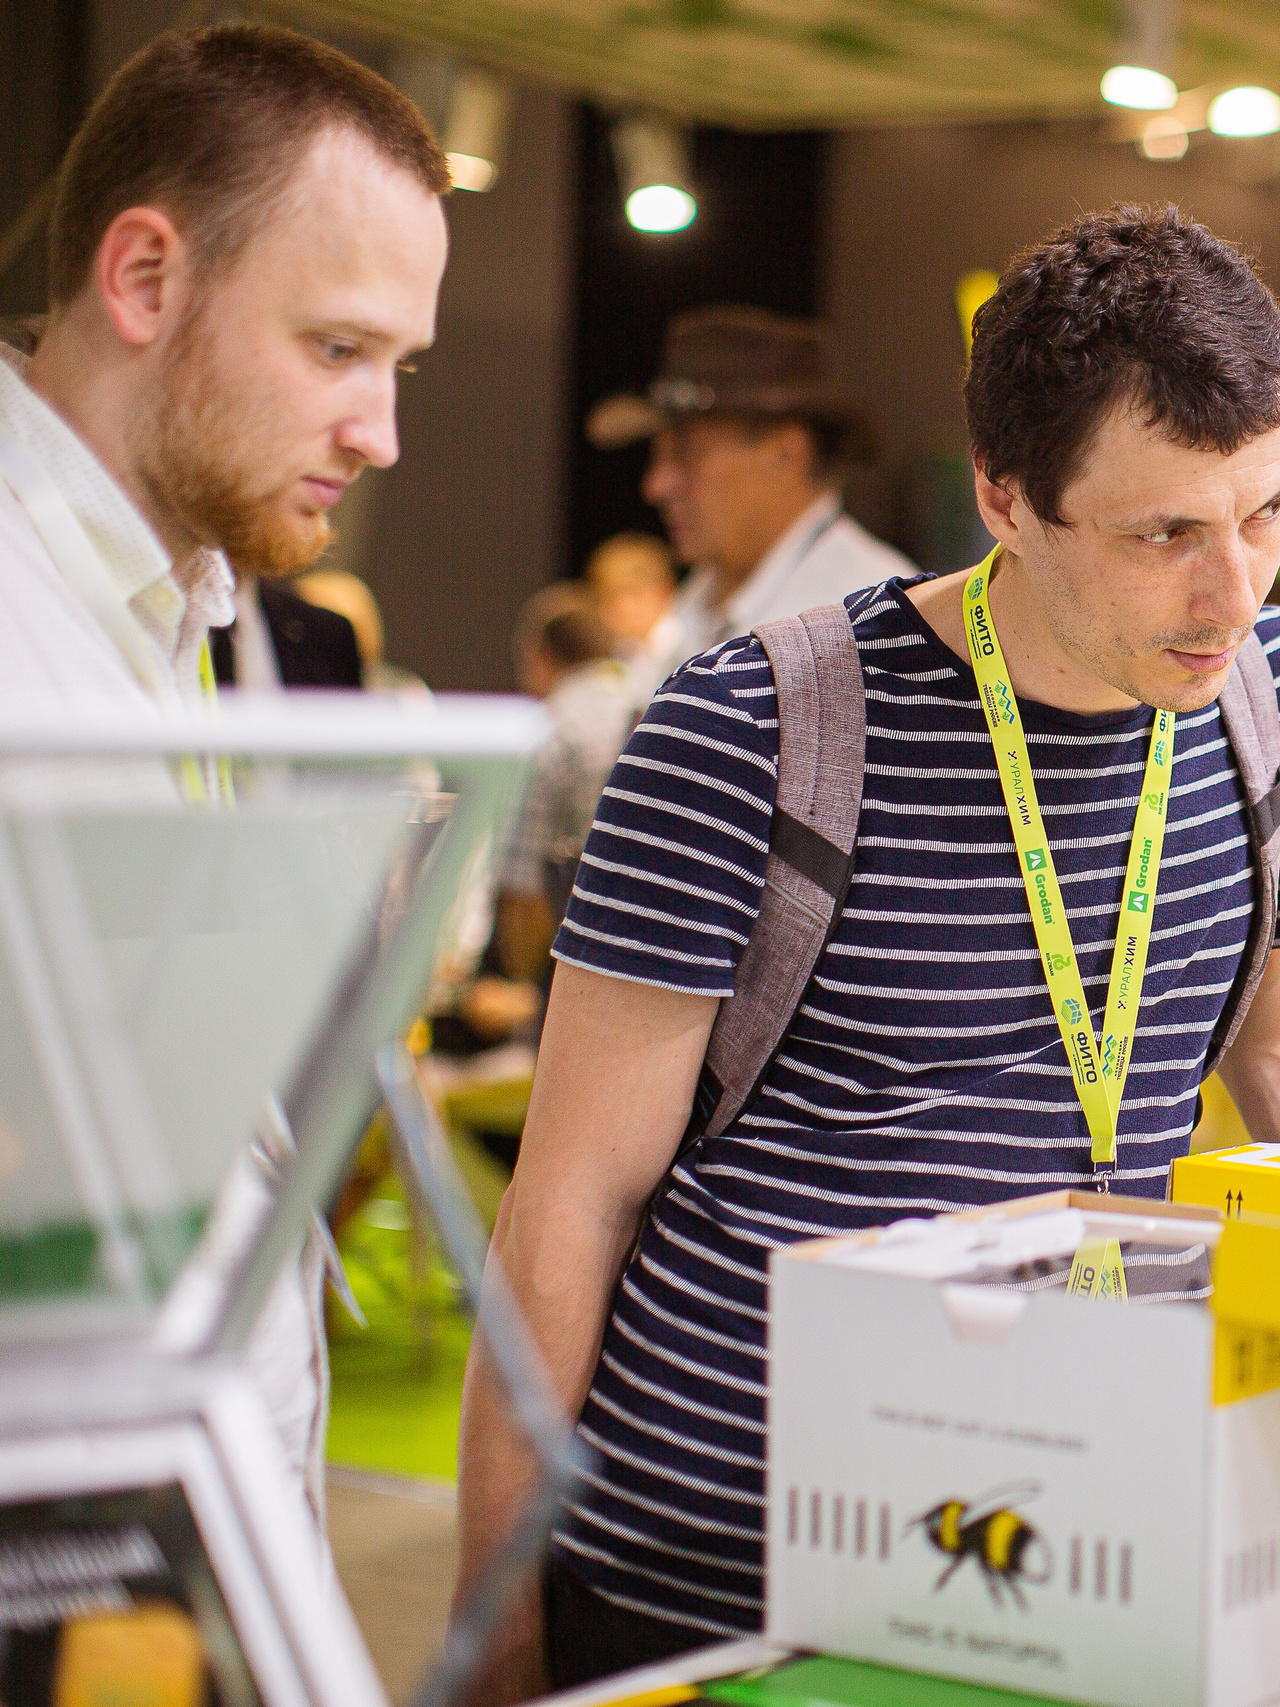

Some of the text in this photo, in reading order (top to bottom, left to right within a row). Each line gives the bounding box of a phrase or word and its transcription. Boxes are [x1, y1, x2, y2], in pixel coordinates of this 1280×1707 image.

[974, 605, 995, 656] ФИТО
[1009, 761, 1032, 826] УРАЛХИМ
[1136, 838, 1152, 889] Grodan
[1035, 873, 1054, 925] Grodan
[1119, 936, 1138, 998] УРАЛХИМ
[1076, 1031, 1098, 1084] ФИТО
